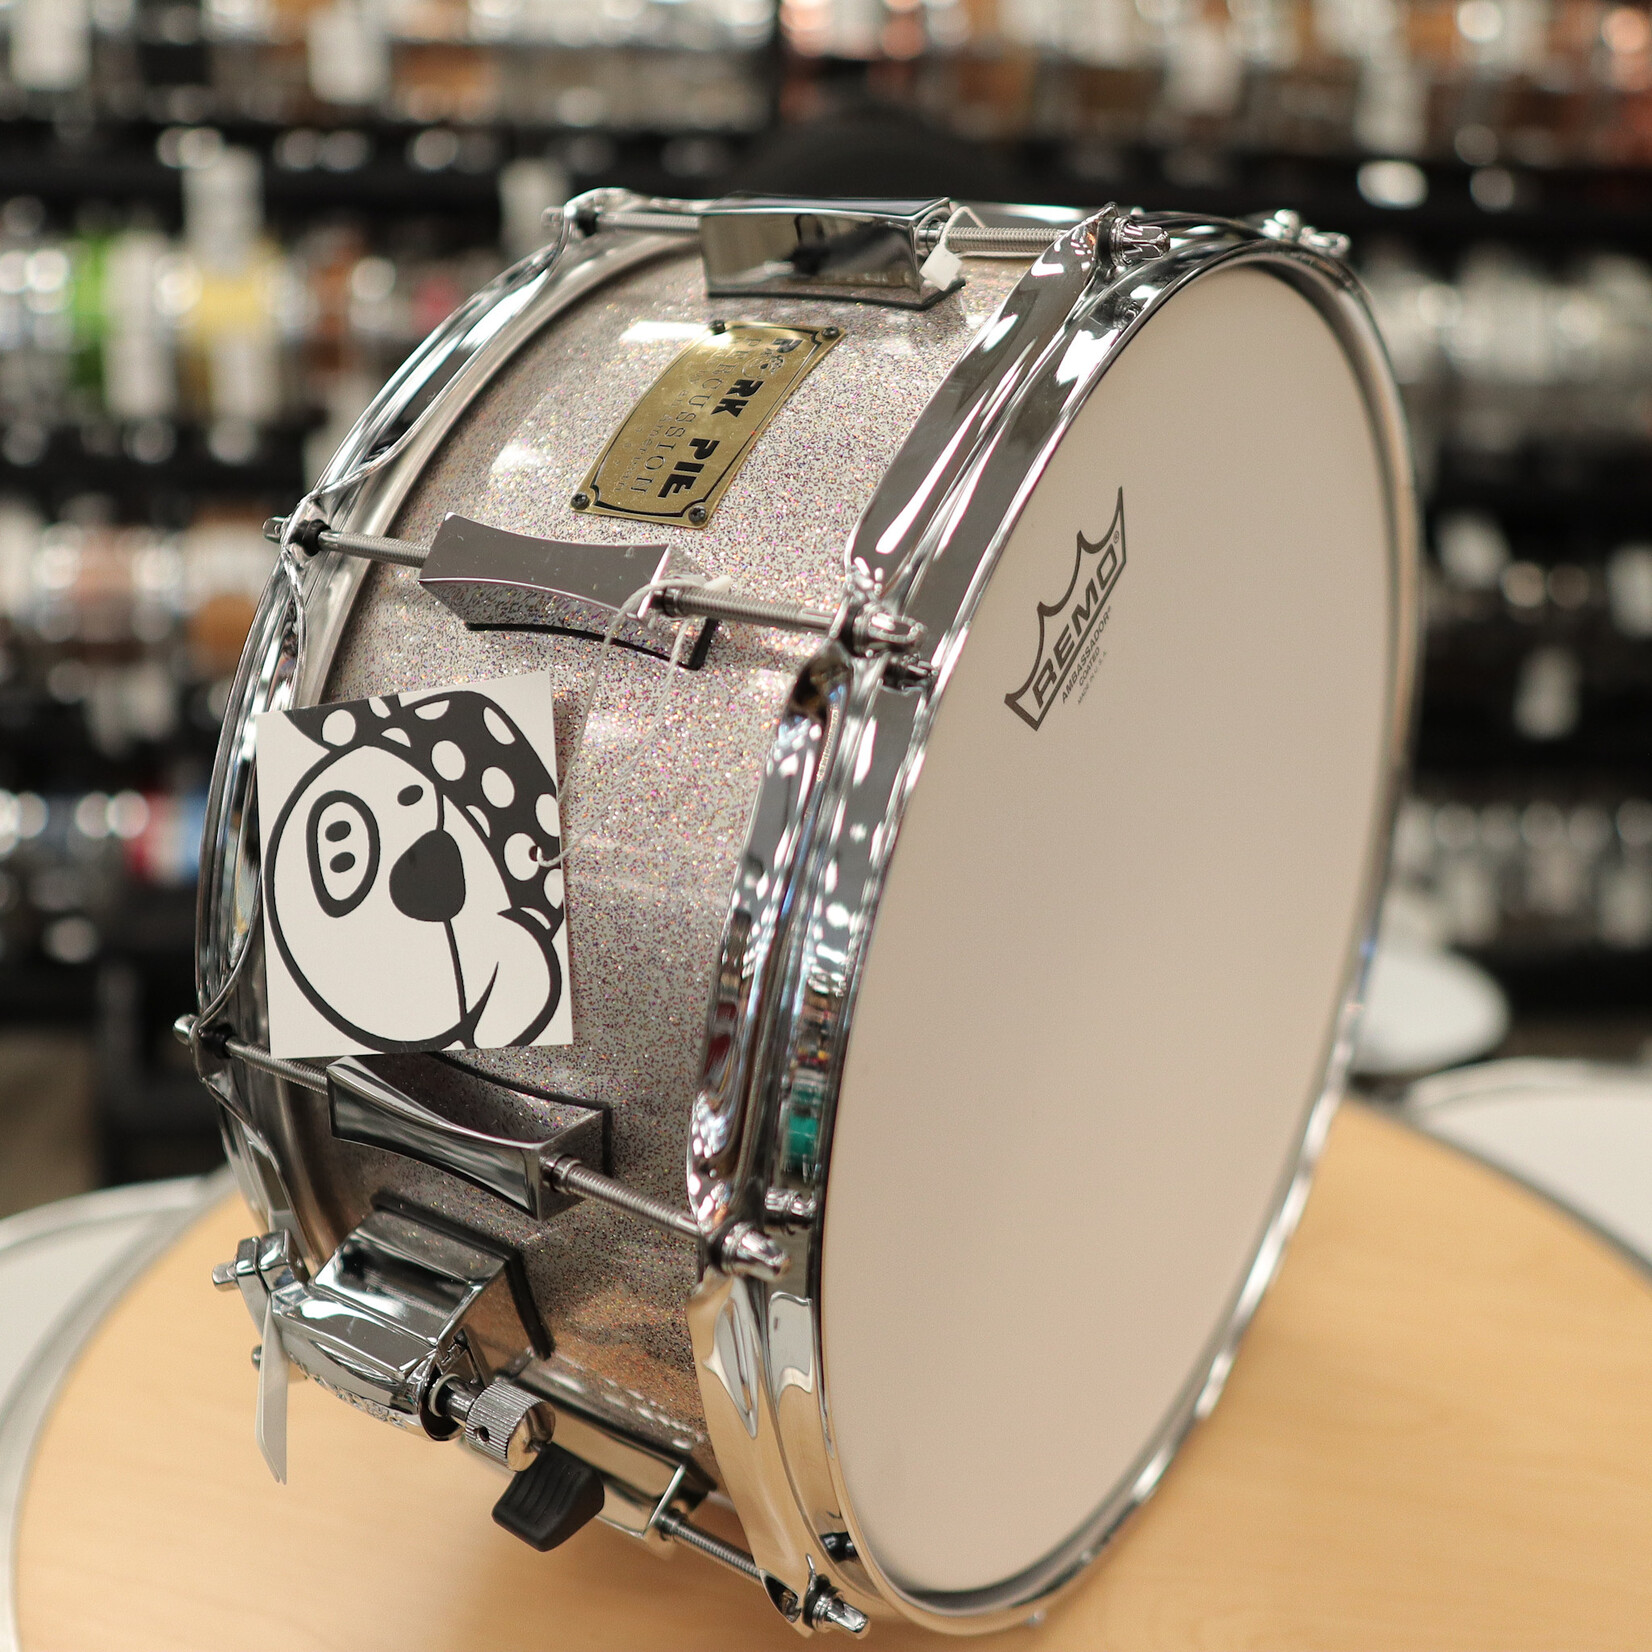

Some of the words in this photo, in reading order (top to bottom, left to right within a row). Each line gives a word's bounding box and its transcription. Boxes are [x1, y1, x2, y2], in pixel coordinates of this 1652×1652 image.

[630, 338, 762, 492] PERCUSSION
[657, 438, 720, 498] PIE
[1032, 543, 1118, 709] REMO
[1079, 646, 1100, 687] COATED
